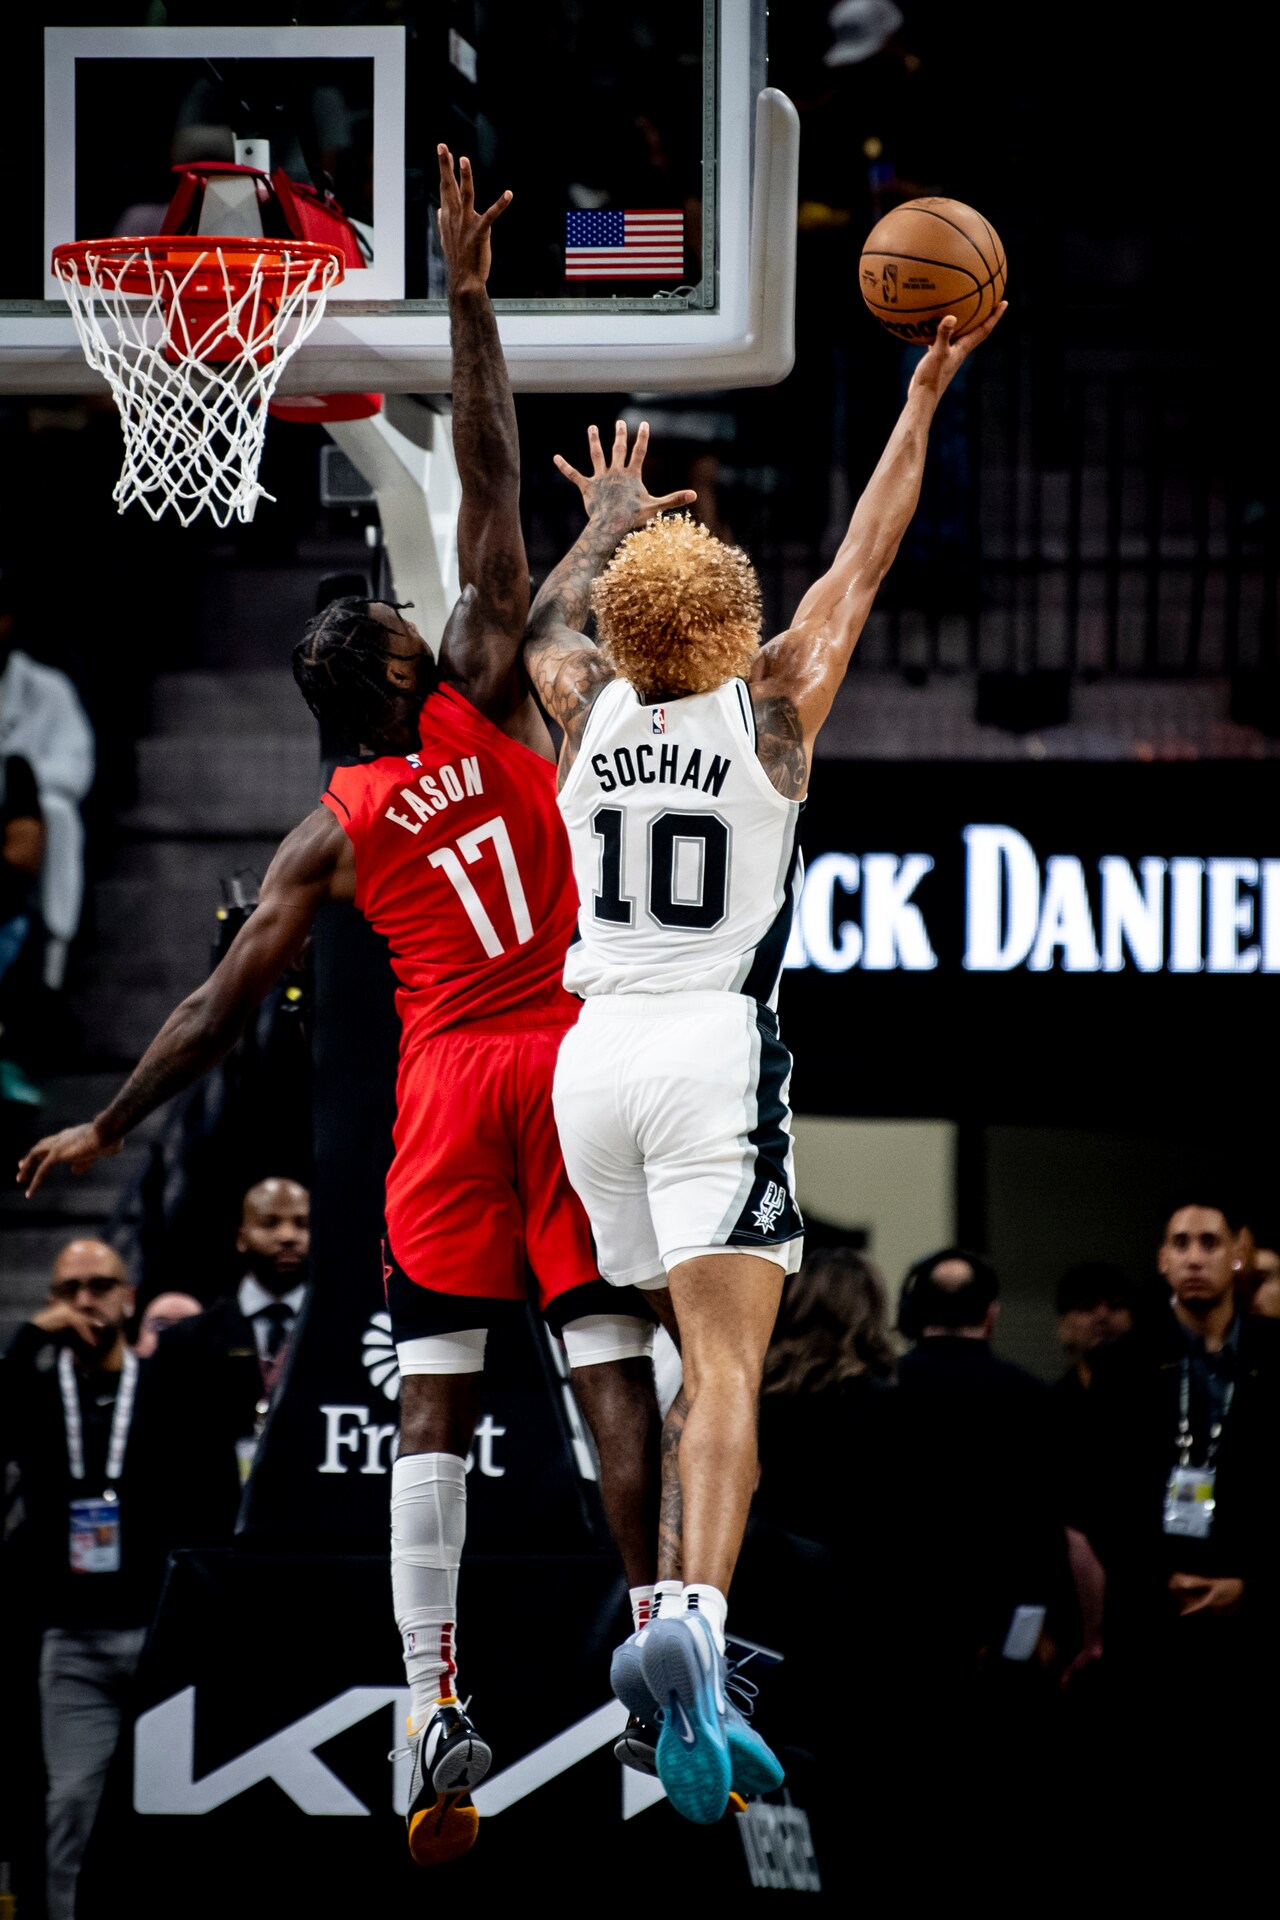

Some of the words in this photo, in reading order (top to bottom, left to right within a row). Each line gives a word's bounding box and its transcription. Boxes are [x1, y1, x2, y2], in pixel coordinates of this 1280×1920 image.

[385, 756, 484, 835] EASON
[591, 744, 731, 797] SOCHAN
[427, 815, 535, 959] 17
[589, 803, 733, 934] 10
[783, 851, 938, 973] CK
[317, 1404, 506, 1478] Frt
